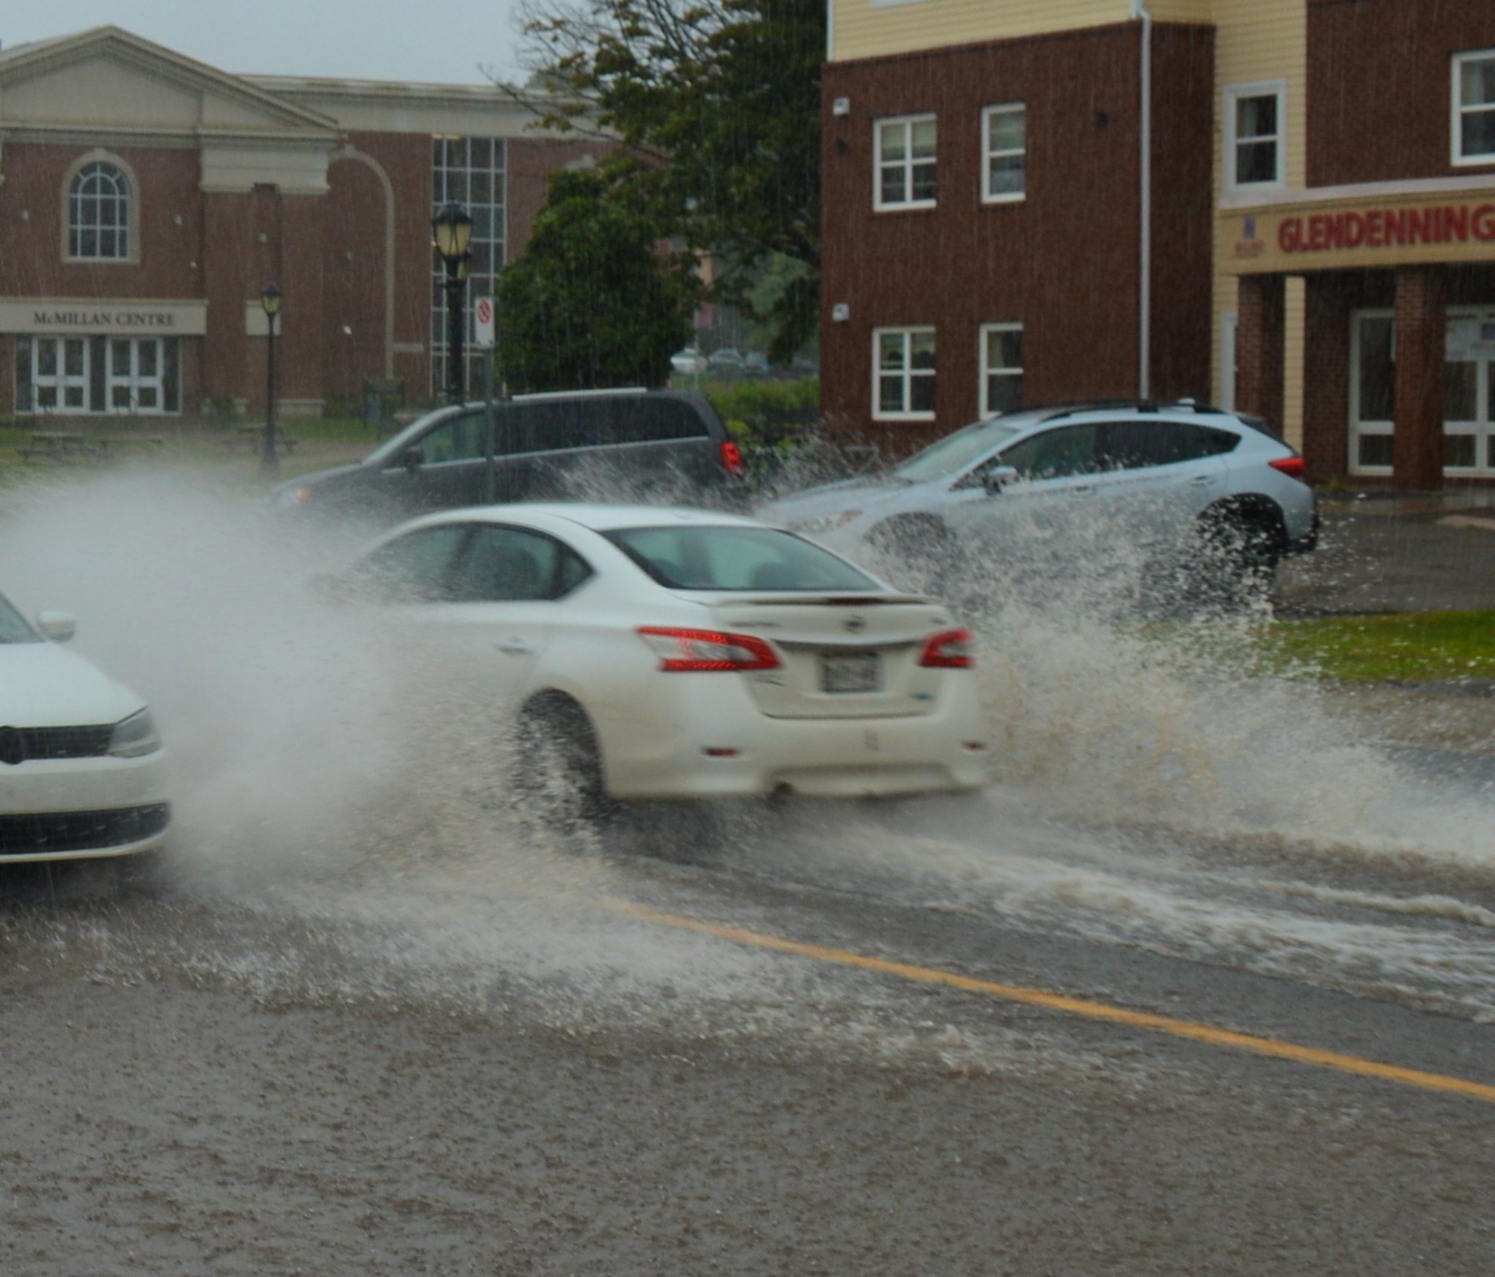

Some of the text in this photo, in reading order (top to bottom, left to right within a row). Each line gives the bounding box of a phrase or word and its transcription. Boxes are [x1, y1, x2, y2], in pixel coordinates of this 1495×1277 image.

[1278, 204, 1495, 252] GLENDENNING
[34, 312, 176, 326] McMILLAN CENTRE
